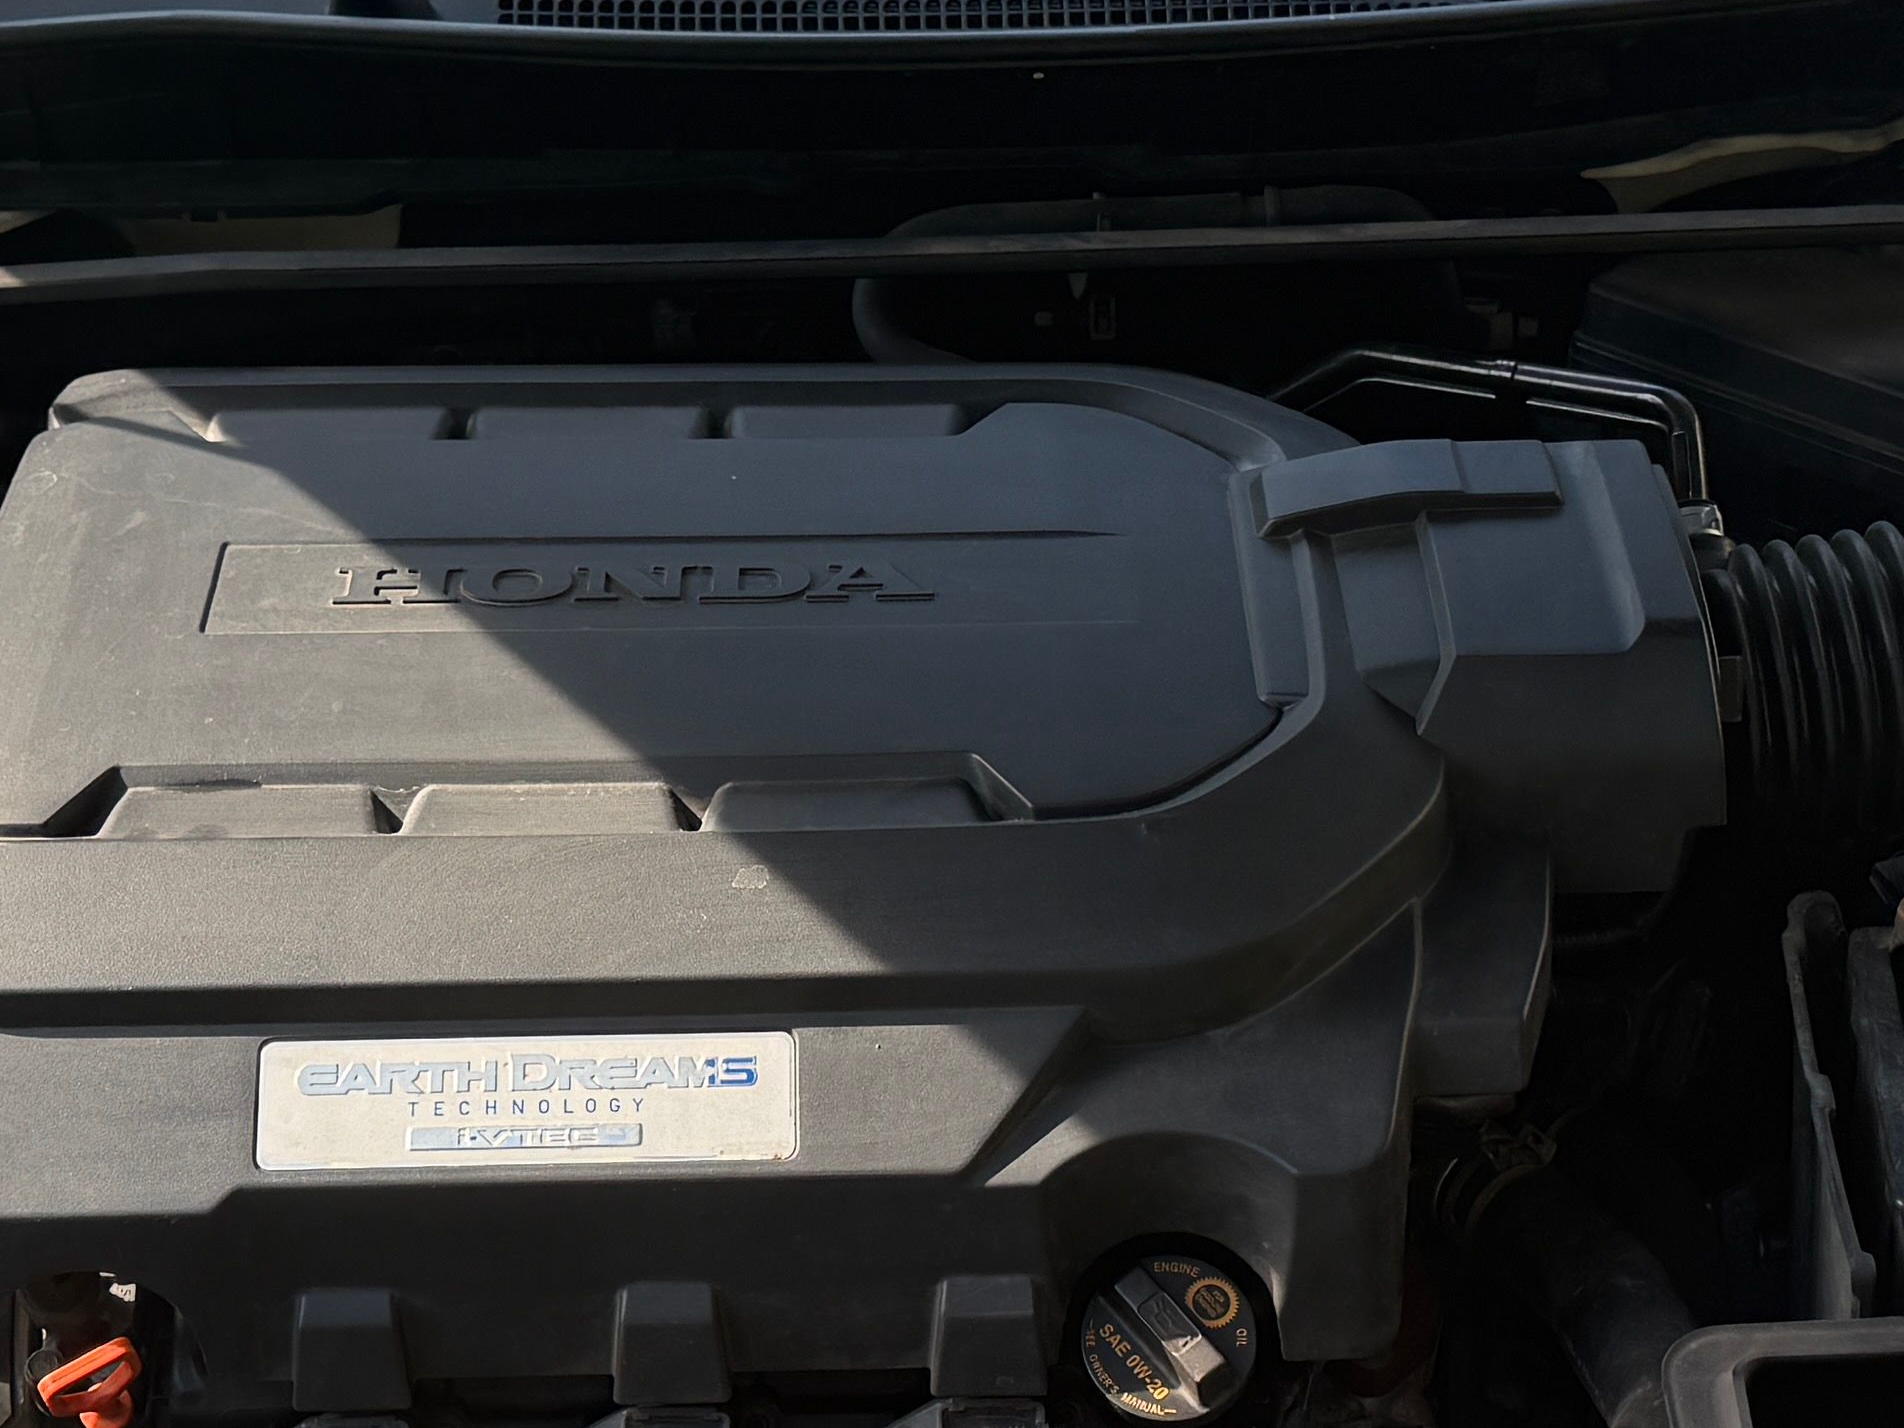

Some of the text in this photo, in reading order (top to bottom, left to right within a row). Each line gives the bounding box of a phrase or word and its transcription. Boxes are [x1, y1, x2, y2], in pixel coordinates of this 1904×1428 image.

[331, 566, 936, 605] HONDA
[297, 1053, 759, 1096] EARTH DREAMS
[407, 1097, 645, 1117] TECHNOLOGY
[1153, 1261, 1248, 1347] ENGINE OIL
[1099, 1323, 1170, 1401] SAE 0W-20
